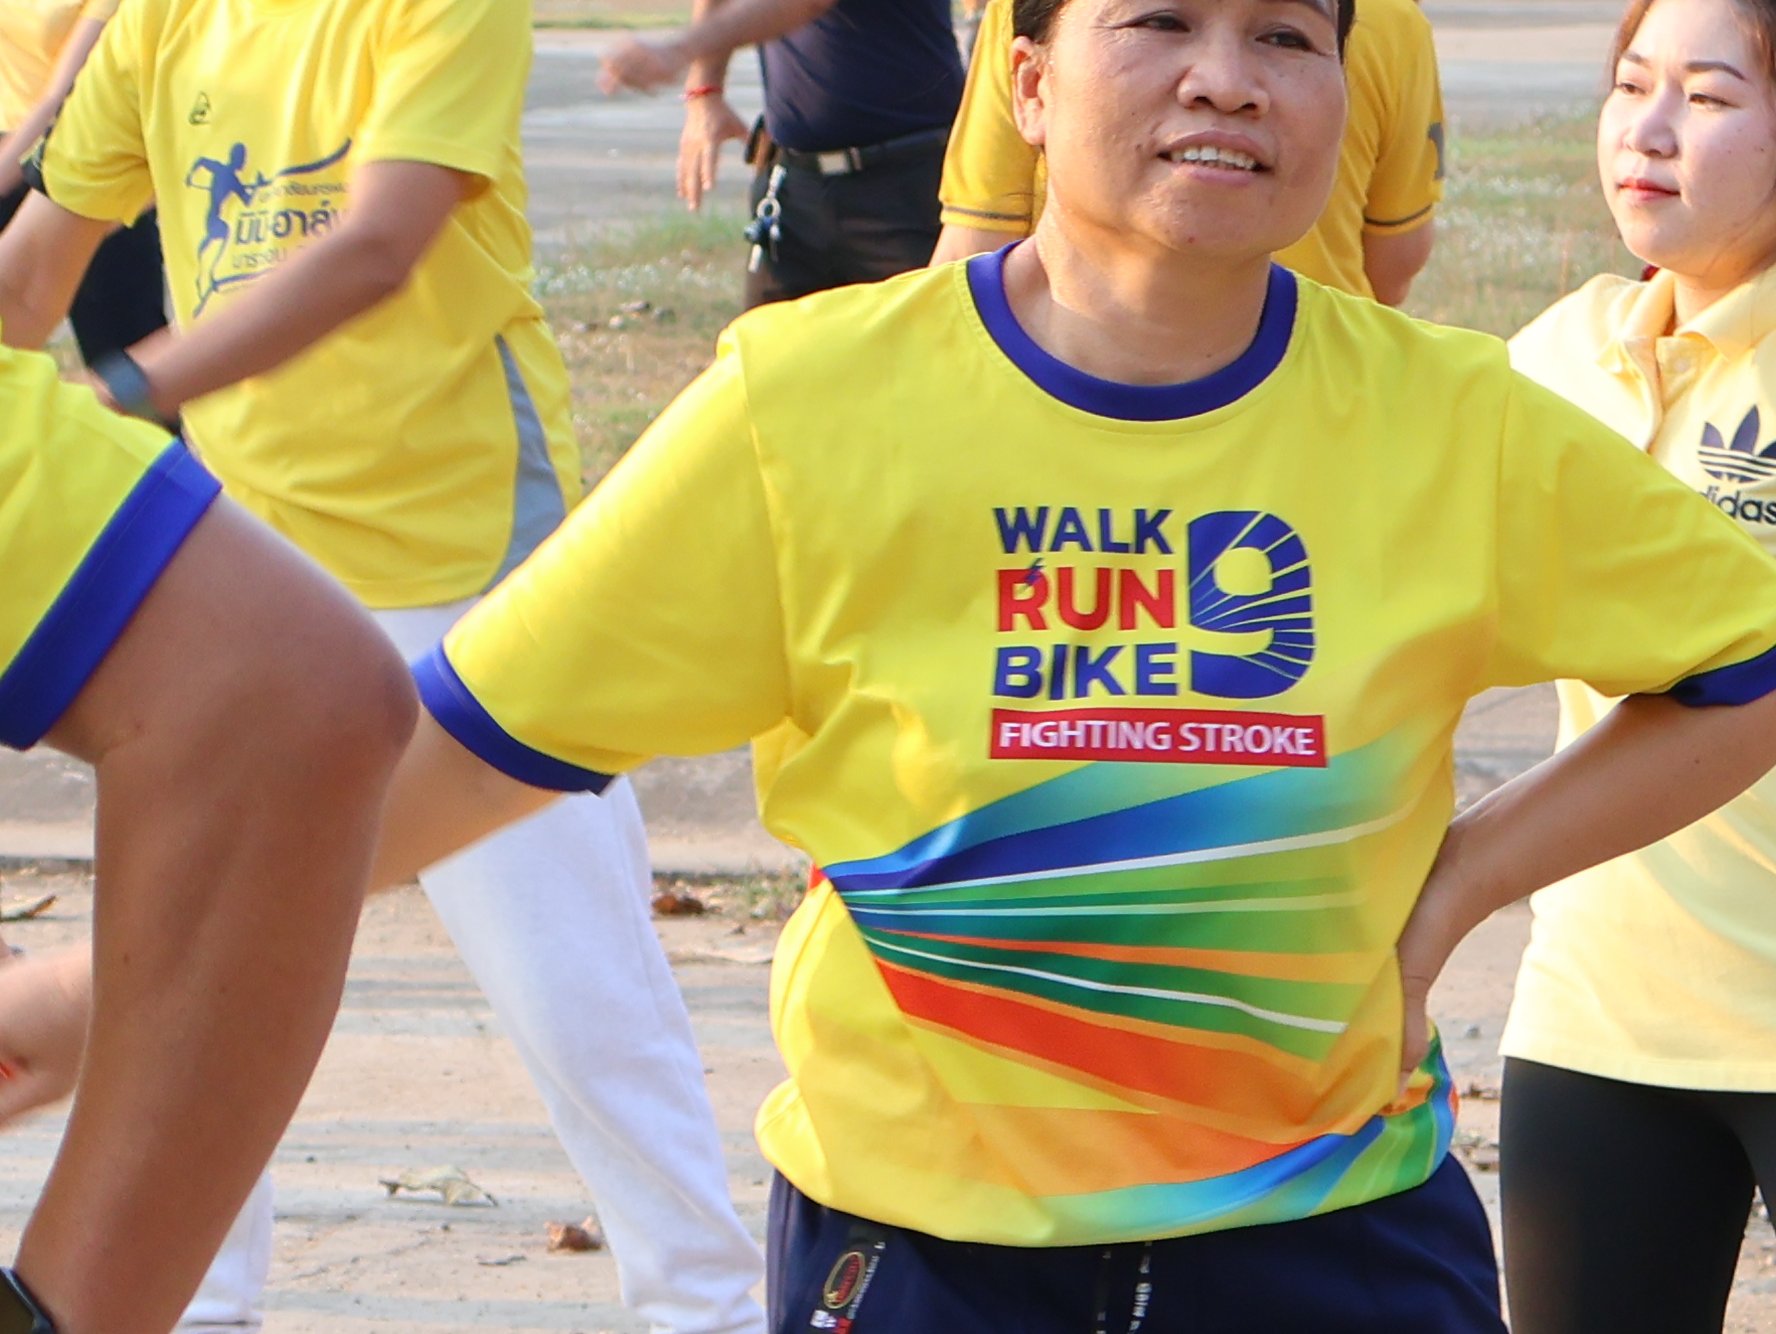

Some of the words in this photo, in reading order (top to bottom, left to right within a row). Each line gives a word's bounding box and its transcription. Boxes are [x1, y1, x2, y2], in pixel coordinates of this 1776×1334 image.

[992, 505, 1174, 555] WALK
[996, 566, 1177, 633] RUN
[1187, 510, 1317, 699] 9
[991, 642, 1179, 701] BIKE
[998, 719, 1173, 751] FIGHTING
[1177, 722, 1319, 757] STROKE
